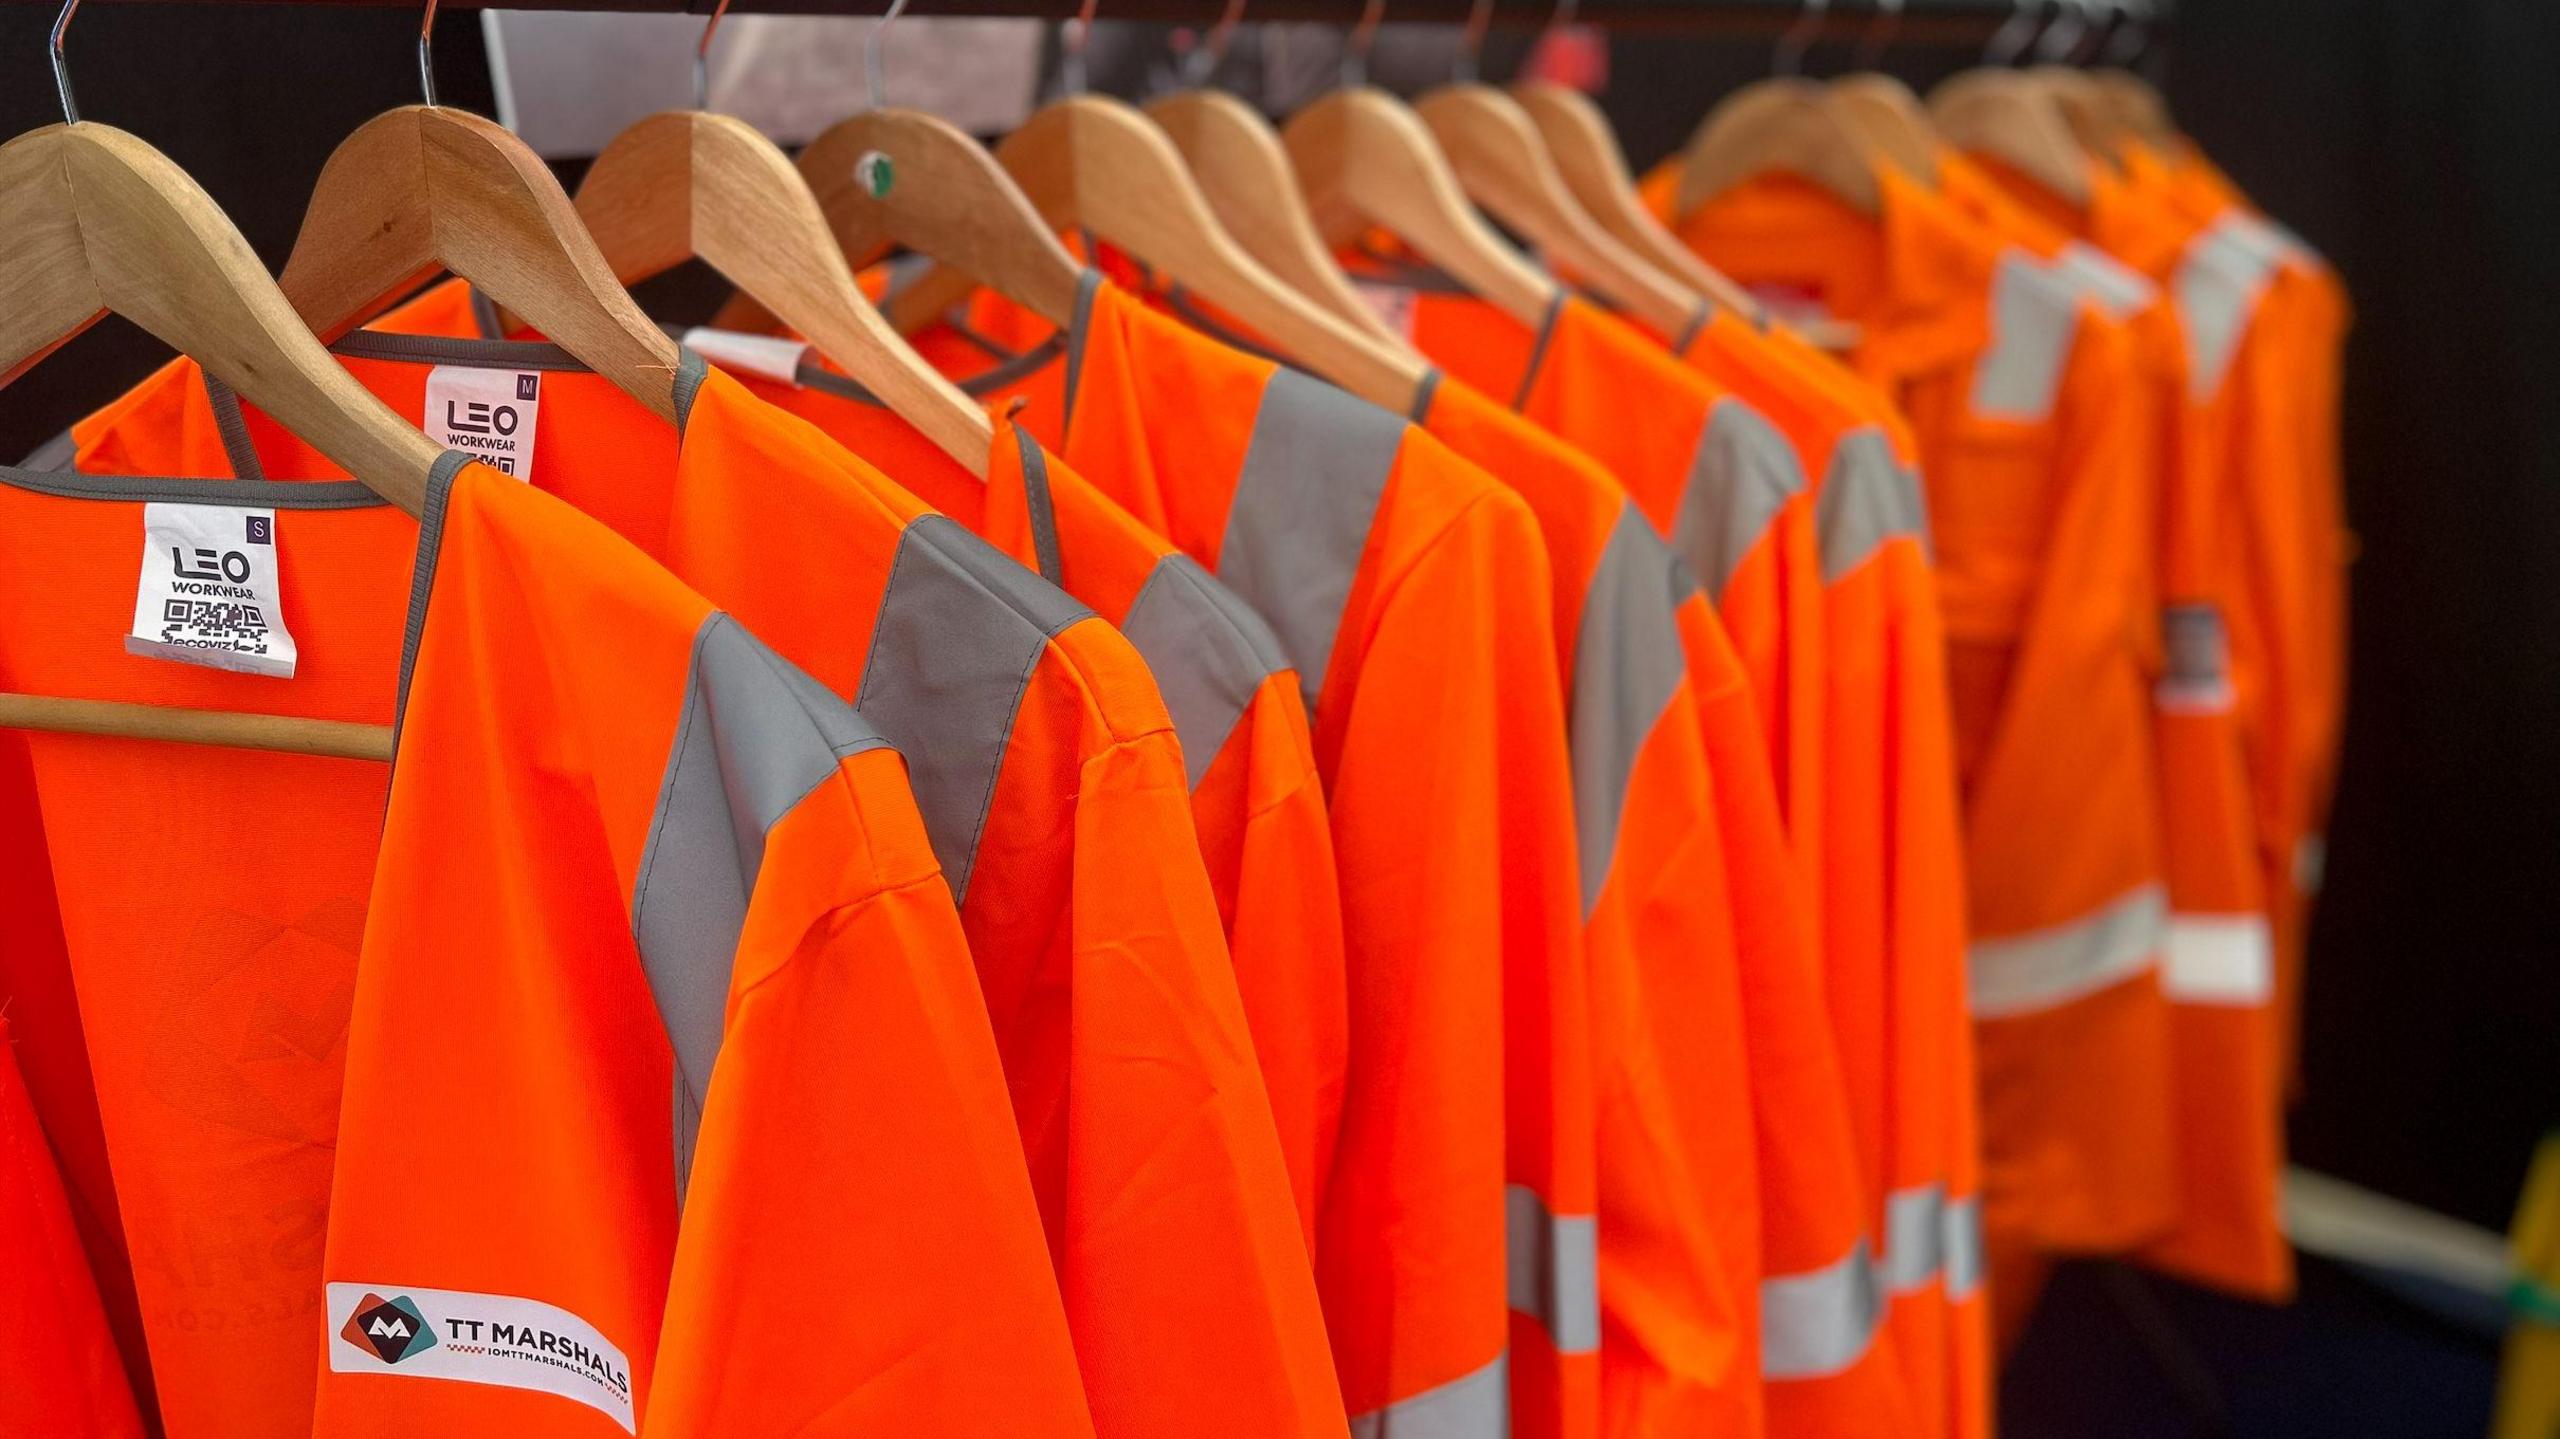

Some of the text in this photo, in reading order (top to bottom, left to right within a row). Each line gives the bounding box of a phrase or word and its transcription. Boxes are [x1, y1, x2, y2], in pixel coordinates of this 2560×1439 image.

[522, 379, 533, 395] M
[447, 400, 518, 436] LEO
[447, 434, 516, 452] WORKWEAR
[253, 520, 265, 538] S
[171, 546, 251, 584] LEO
[171, 581, 256, 601] WORKWEAR
[445, 1317, 628, 1394] TT MARSHALS
[487, 1347, 604, 1387] IOMTTMARSHALS.COM
